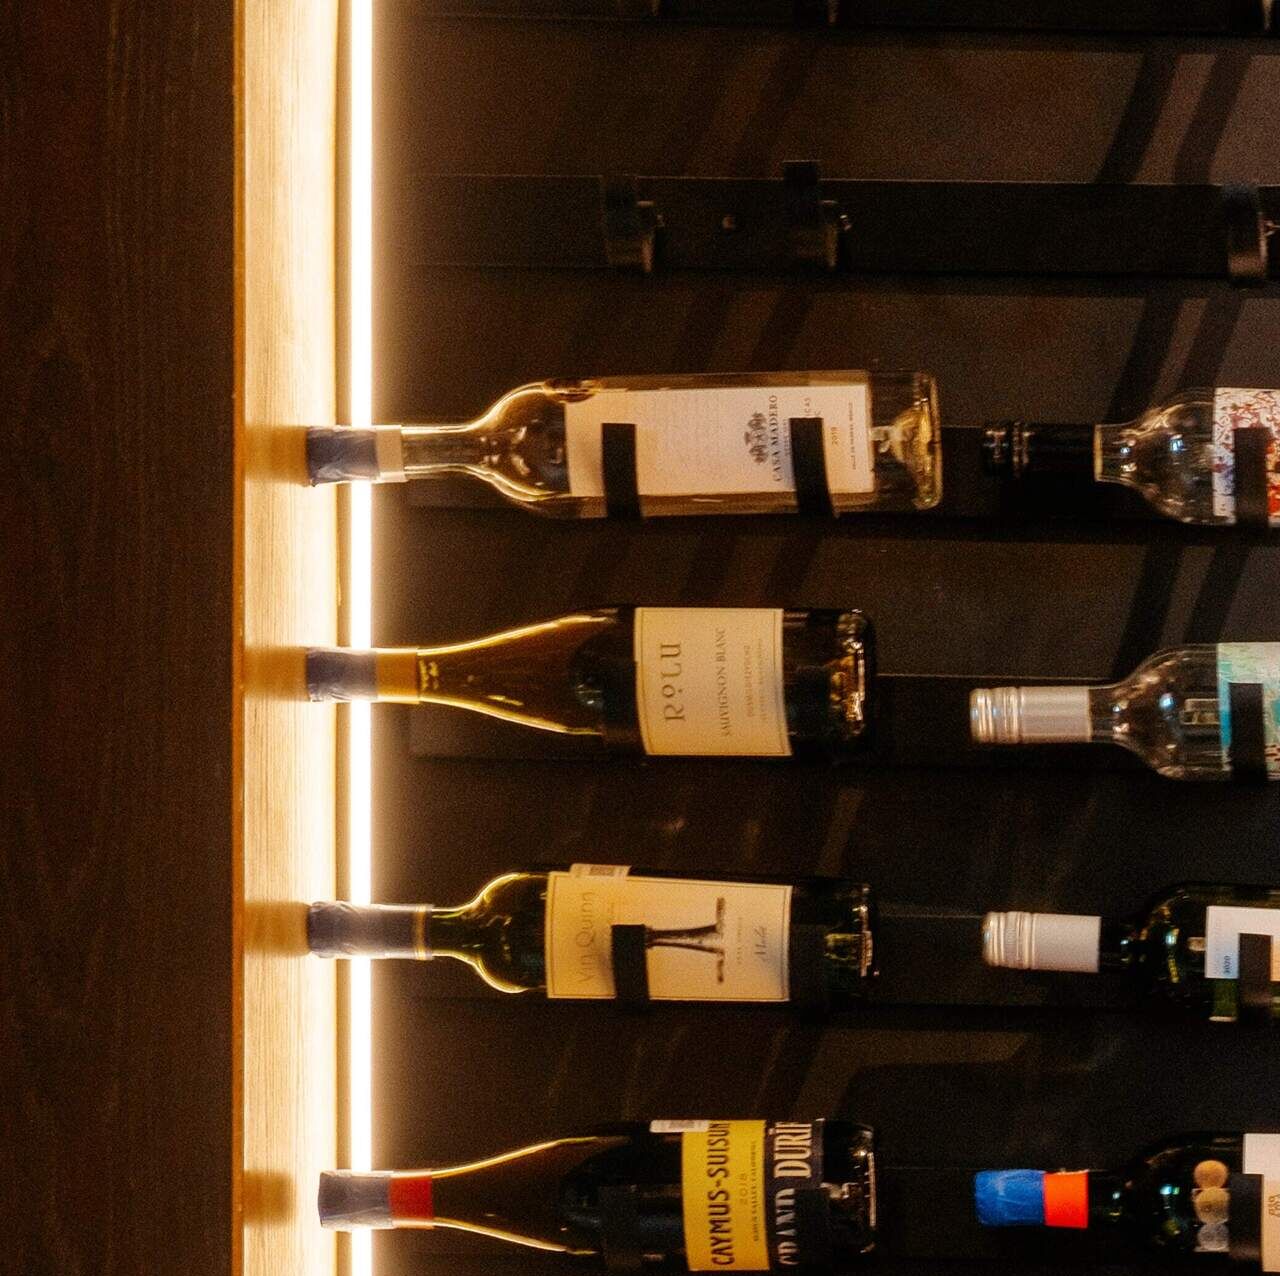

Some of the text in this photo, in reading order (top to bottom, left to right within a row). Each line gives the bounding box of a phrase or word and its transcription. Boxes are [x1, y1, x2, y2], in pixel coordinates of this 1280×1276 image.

[768, 395, 783, 482] CASA MADERO
[714, 627, 732, 736] SAUVIGNON BLANC
[706, 1123, 736, 1266] CAYMUS-SUISUN
